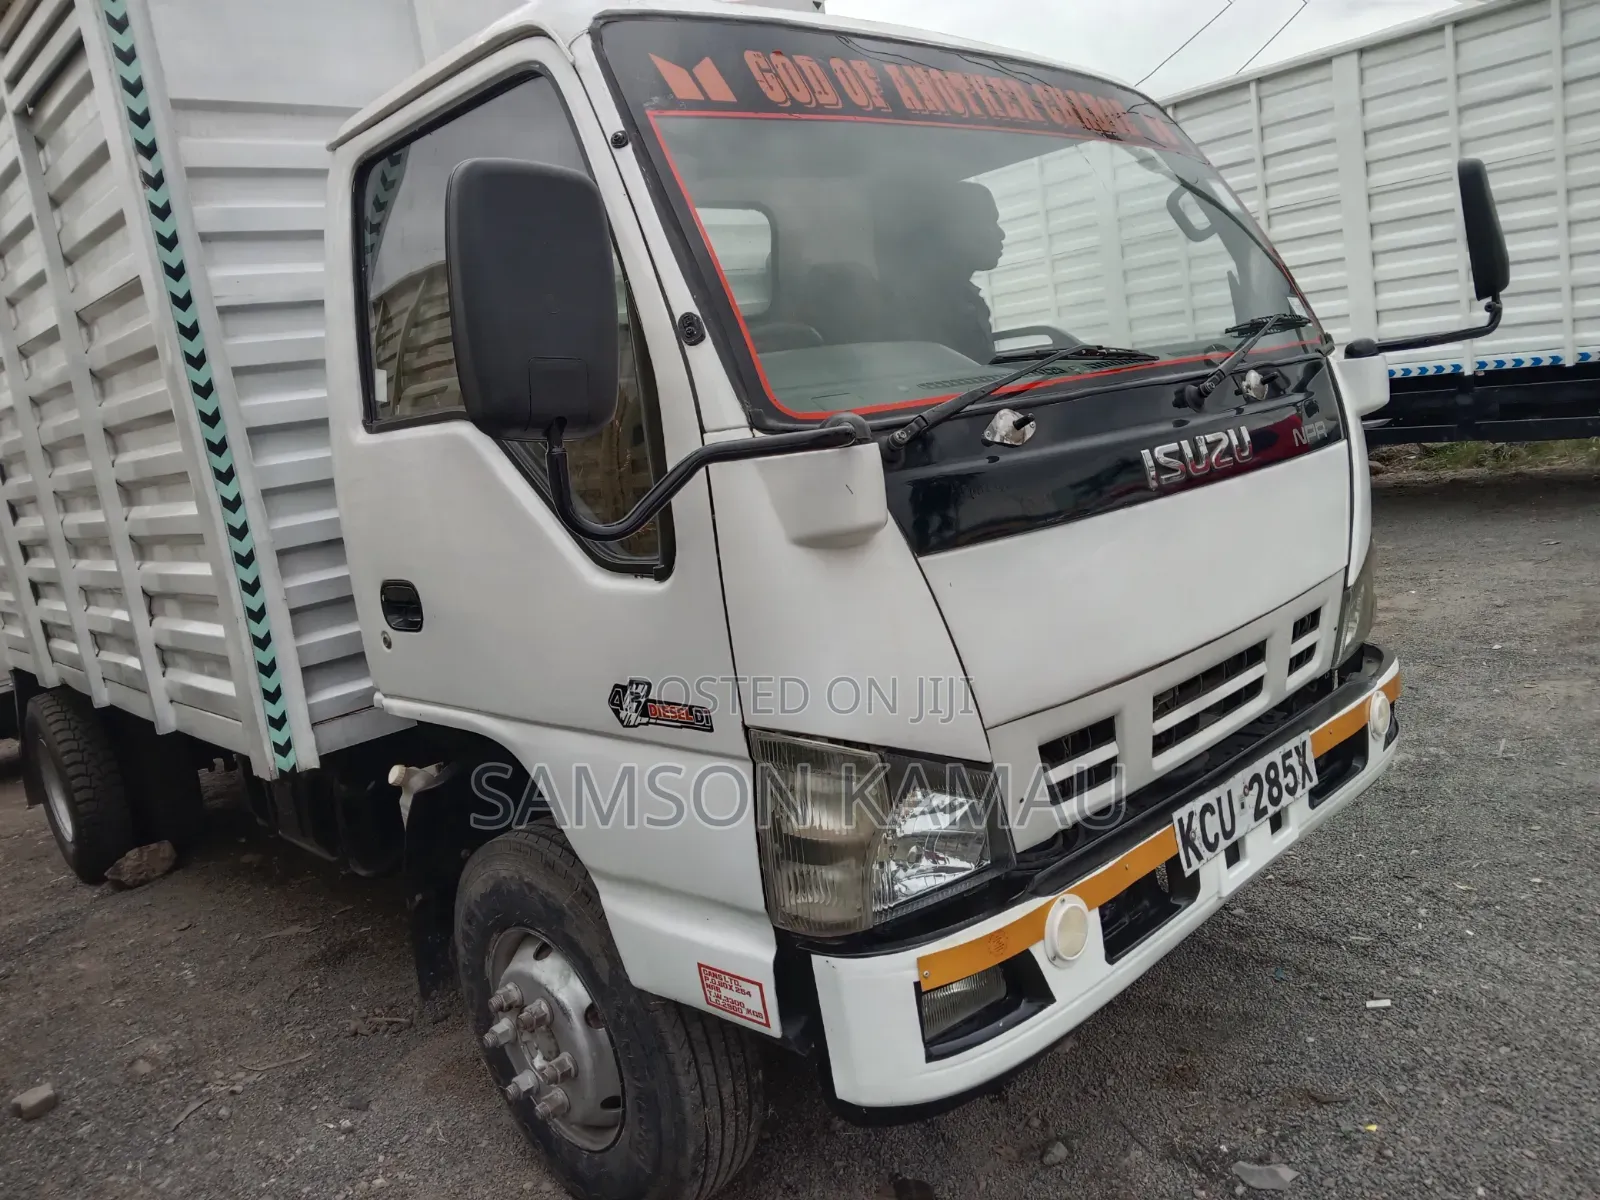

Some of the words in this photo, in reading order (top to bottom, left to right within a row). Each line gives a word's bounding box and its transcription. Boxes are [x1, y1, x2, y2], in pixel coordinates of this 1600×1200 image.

[744, 50, 842, 108] GOD
[829, 57, 892, 112] OF
[884, 64, 1048, 124] ANOTHER
[1141, 425, 1253, 491] ISUZU
[1292, 420, 1328, 447] NPR
[647, 702, 694, 721] DIESEL
[1177, 788, 1236, 869] KCU
[1249, 739, 1314, 822] 285X
